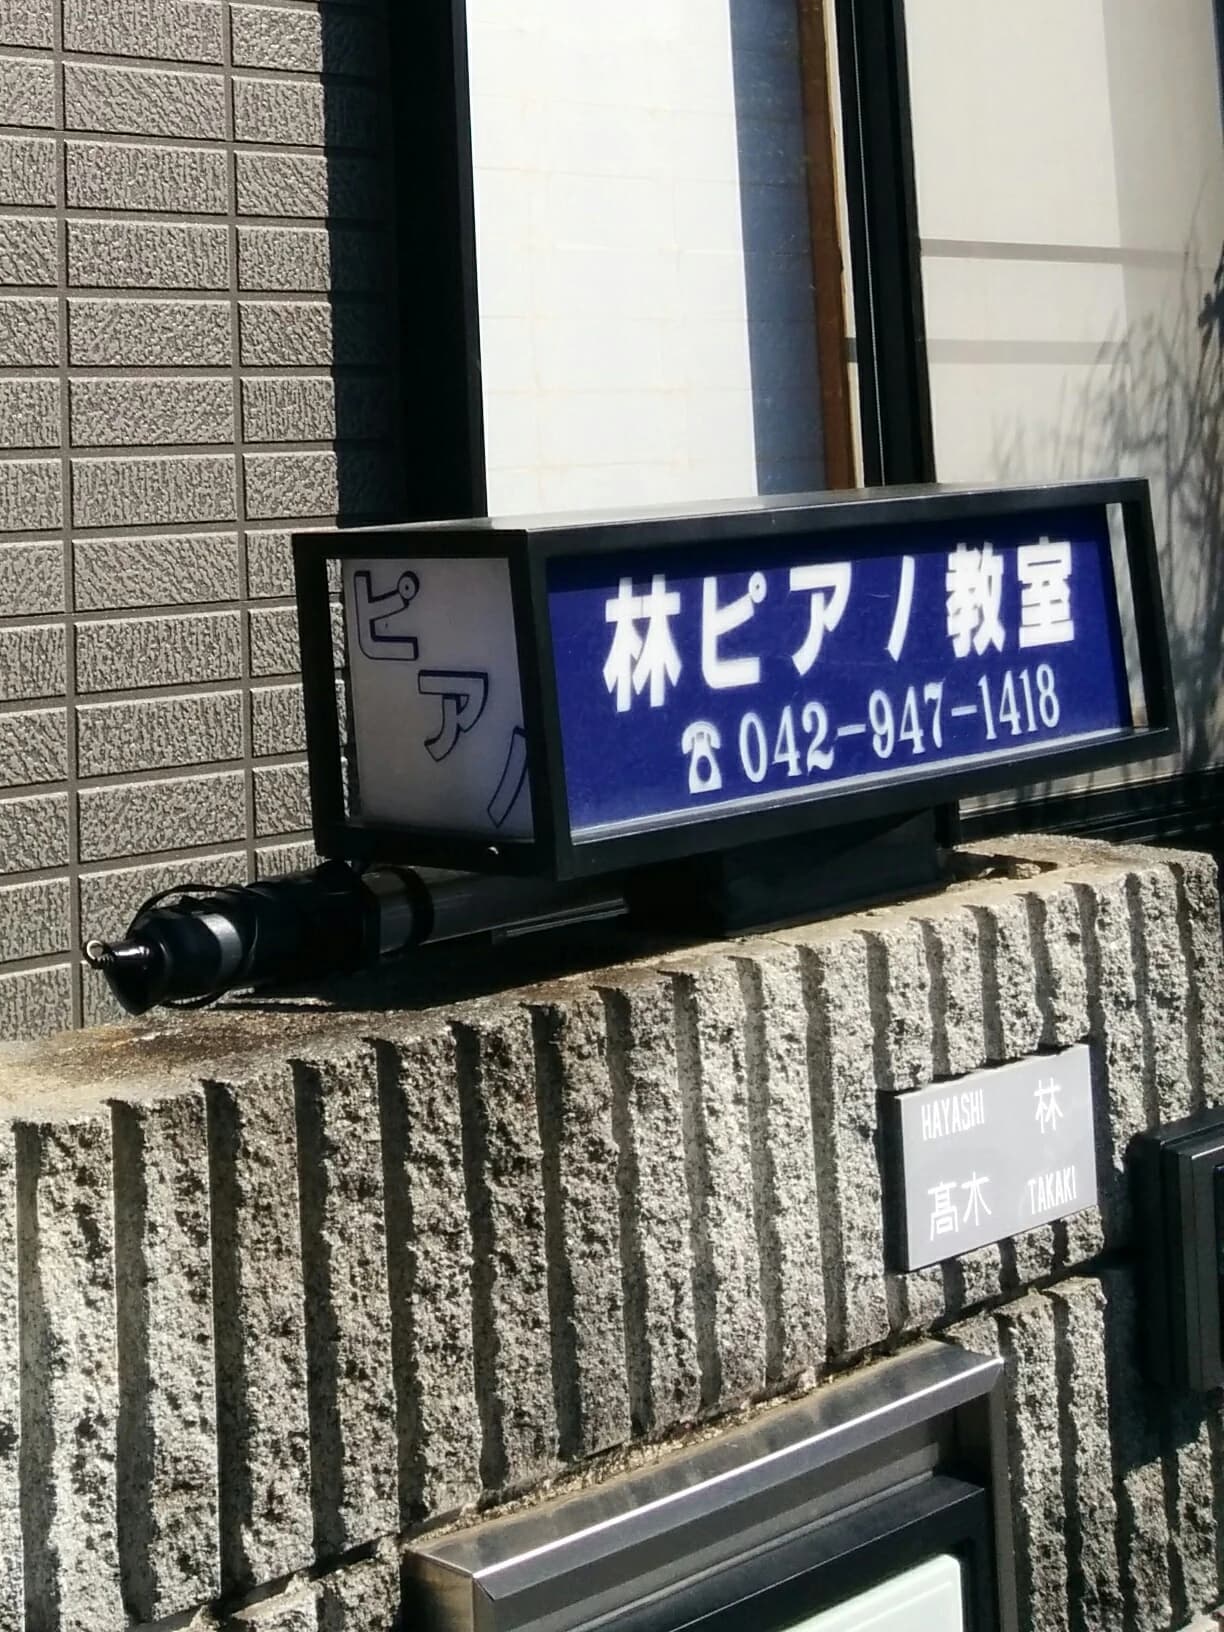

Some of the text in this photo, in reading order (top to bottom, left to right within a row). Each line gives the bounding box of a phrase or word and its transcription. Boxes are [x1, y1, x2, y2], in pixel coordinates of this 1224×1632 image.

[603, 536, 1075, 713] 林ピアノ教室
[353, 569, 528, 829] ピアノ
[739, 664, 1060, 784] 042-947-1418
[921, 1088, 985, 1141] HAYASHI
[1033, 1077, 1063, 1134] 林
[1027, 1165, 1077, 1215] TAKAKI
